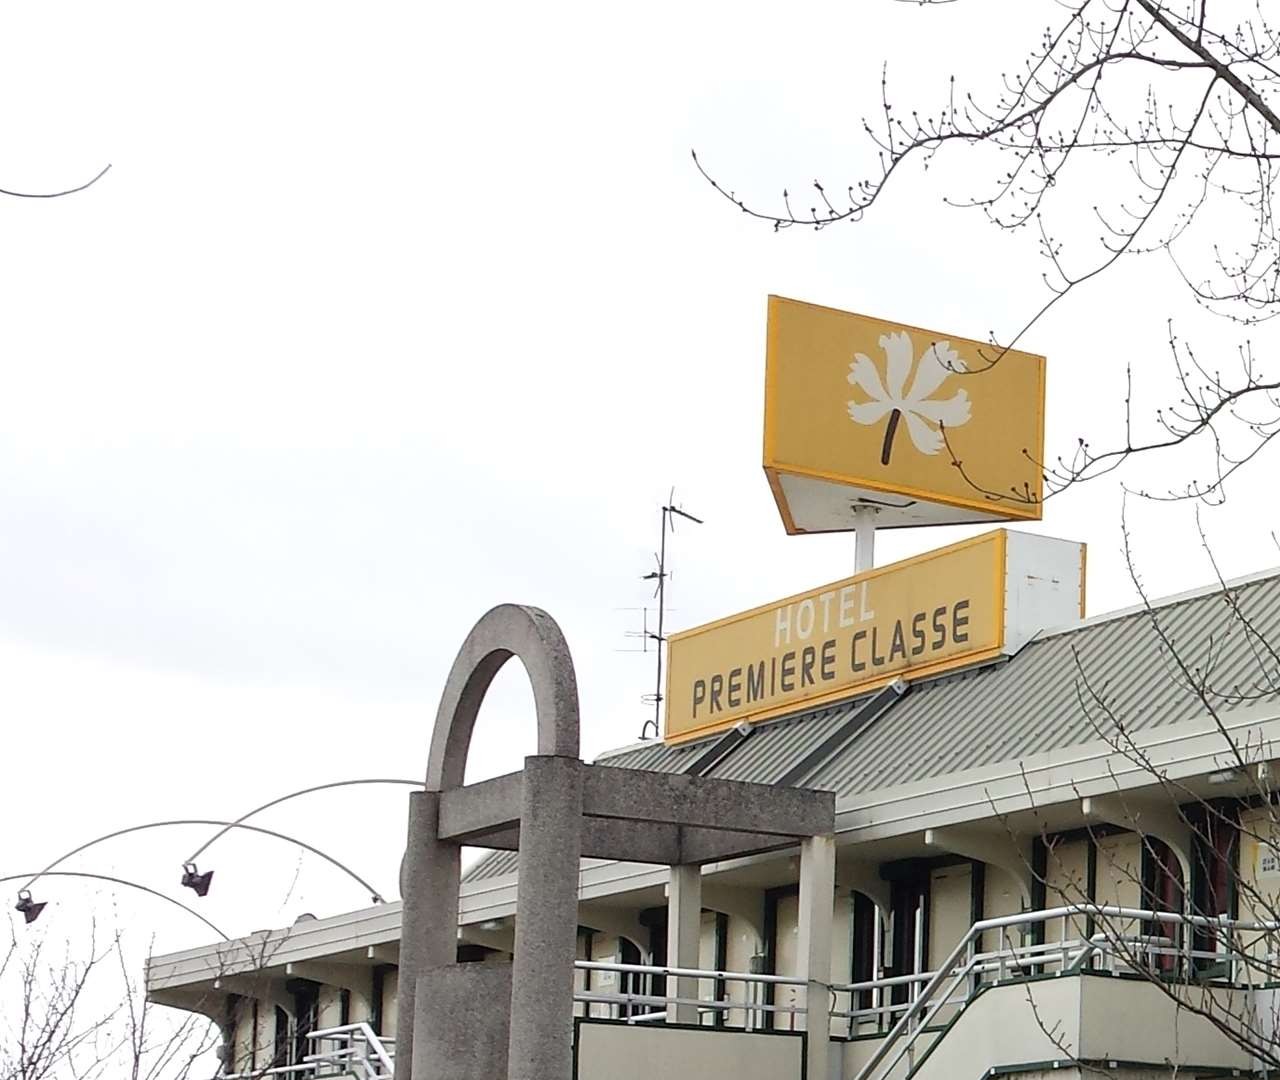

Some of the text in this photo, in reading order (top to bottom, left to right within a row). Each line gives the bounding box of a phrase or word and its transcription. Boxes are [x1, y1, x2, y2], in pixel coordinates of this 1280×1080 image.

[693, 600, 971, 718] PREMIERE CLASSE
[774, 581, 876, 648] HOTEL
